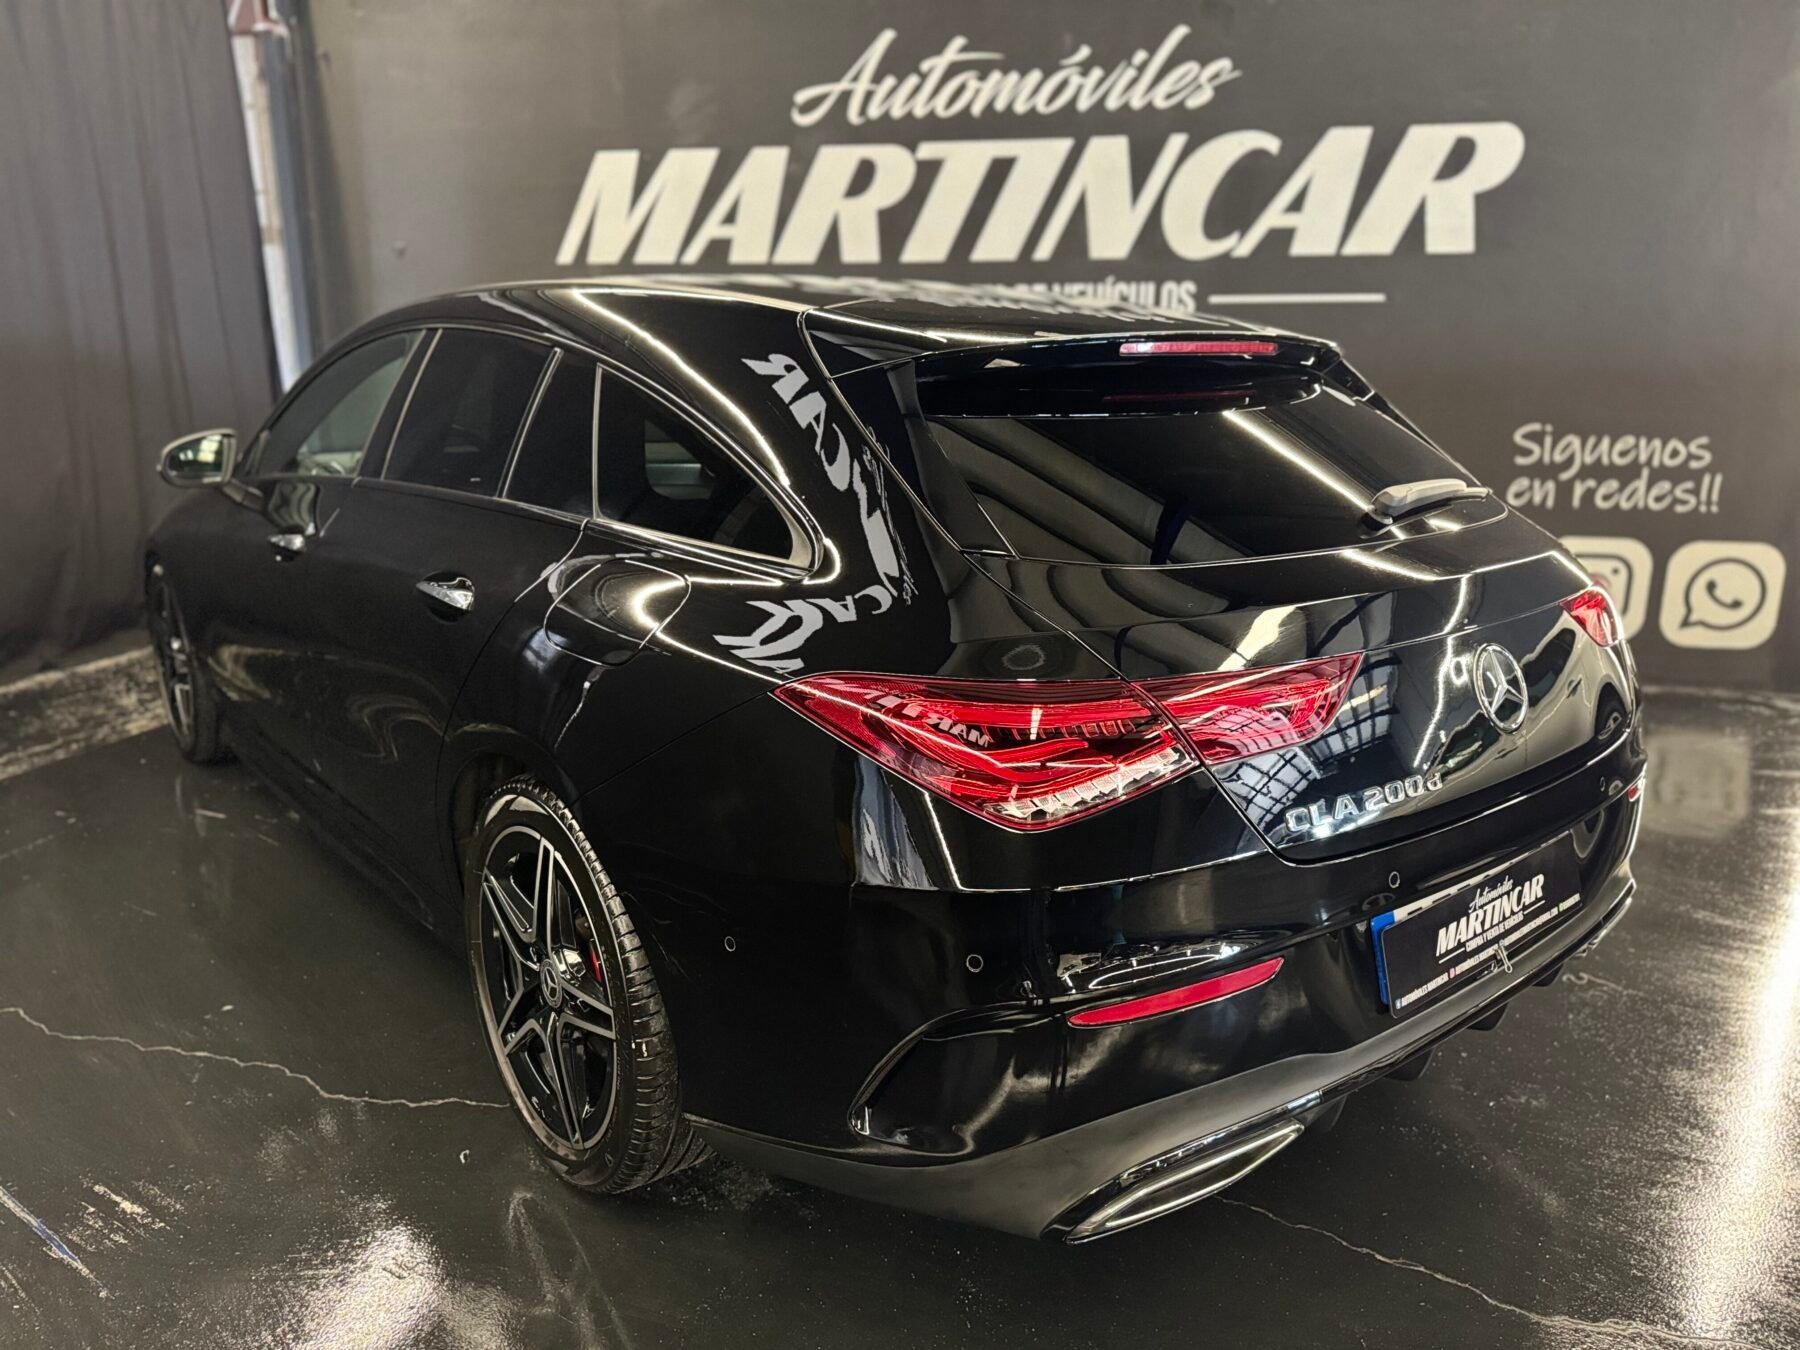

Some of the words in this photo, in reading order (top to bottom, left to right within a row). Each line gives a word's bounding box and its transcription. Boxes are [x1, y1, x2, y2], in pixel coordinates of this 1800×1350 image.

[791, 24, 1241, 126] Automóviles
[556, 121, 1525, 264] MARTINCAR
[1506, 475, 1555, 509] en
[1571, 466, 1723, 514] redes!!
[1285, 794, 1359, 832] CLA
[1436, 874, 1544, 956] MARTINCAR
